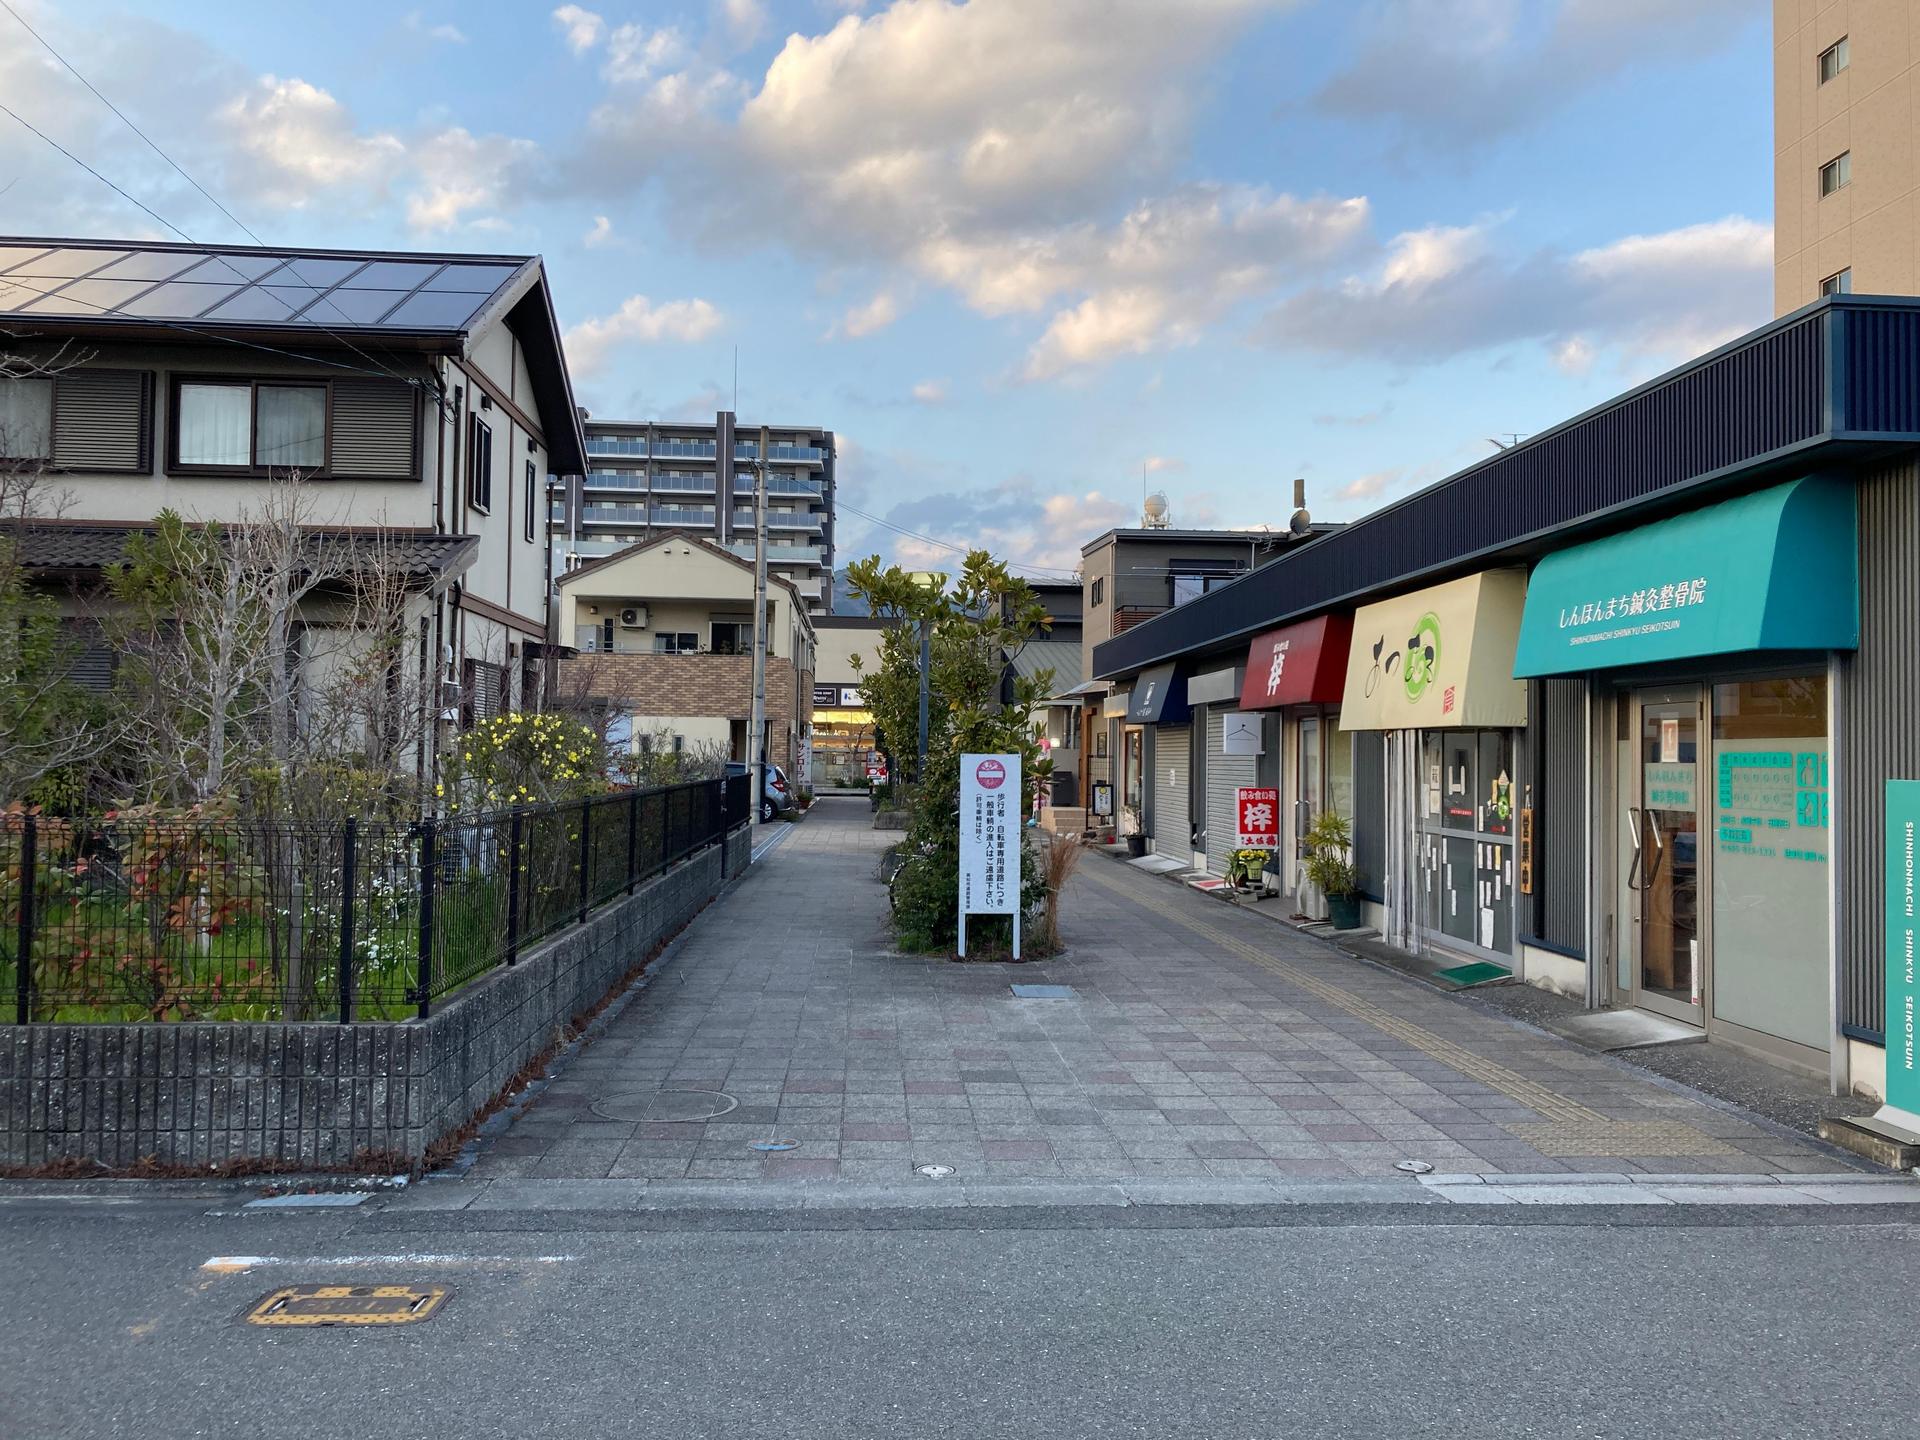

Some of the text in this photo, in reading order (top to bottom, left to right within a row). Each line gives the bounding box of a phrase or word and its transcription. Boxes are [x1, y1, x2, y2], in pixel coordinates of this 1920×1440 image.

[1559, 577, 1707, 628] しんほんまち鍼灸整骨院
[1569, 620, 1681, 646] SHINHONMACHI SHINKYU SEIKOTSUIN
[1244, 803, 1273, 832] 梓
[997, 793, 1005, 906] 歩行者・自転車専用道路につき
[1905, 821, 1914, 1070] SHINHONMACHI SHINKYU SEIKOTSUIN
